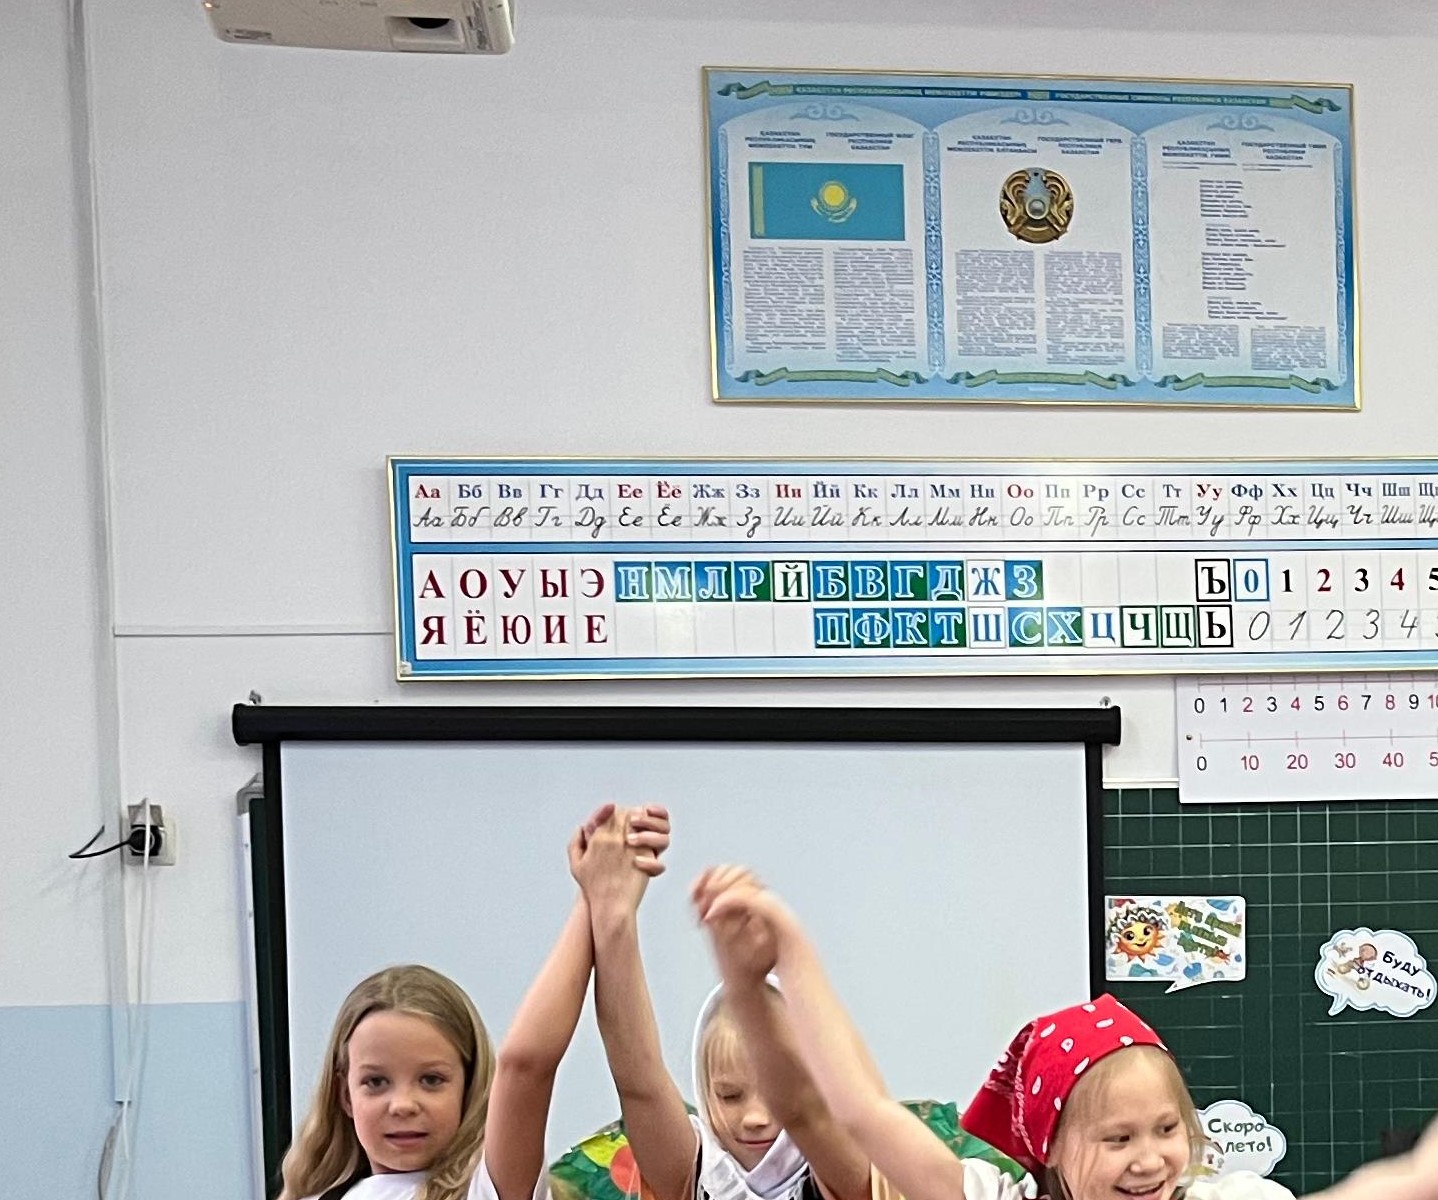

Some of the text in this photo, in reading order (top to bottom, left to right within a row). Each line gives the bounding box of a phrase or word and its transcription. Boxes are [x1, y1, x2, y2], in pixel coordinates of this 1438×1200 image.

[415, 485, 440, 498] Аа
[458, 484, 481, 498] Бб
[499, 484, 522, 498] Вв
[541, 485, 563, 498] Гг
[576, 484, 604, 500] Дд
[618, 484, 642, 498] Ее
[658, 481, 681, 498] Ёё
[693, 484, 724, 498] Жж
[736, 484, 760, 498] Зз
[776, 484, 801, 498] Ии
[814, 482, 840, 498] Йй
[854, 484, 877, 498] Кк
[891, 484, 918, 498] Лл
[931, 485, 959, 497] Мм
[971, 485, 994, 498] Нн
[1008, 485, 1033, 498] Оо
[1046, 485, 1069, 498] Пп
[1084, 485, 1109, 500] Рр
[1122, 484, 1145, 498] Сс
[1163, 484, 1181, 497] Тт
[1197, 484, 1219, 500] Уу
[1232, 484, 1263, 500] Фф
[1273, 484, 1297, 497] Хх
[1312, 484, 1334, 499] Цц
[1346, 484, 1371, 496] Чч
[1383, 483, 1410, 496] Шш
[1244, 570, 1258, 592] 0
[1283, 569, 1292, 592] 1
[1318, 569, 1331, 591] 2
[1355, 568, 1368, 591] 3
[1391, 568, 1404, 590] 4
[1249, 611, 1270, 640] 0
[1290, 611, 1306, 640] 1
[1326, 610, 1344, 639] 2
[1363, 609, 1379, 639] 3
[1401, 610, 1417, 638] 4
[1194, 698, 1204, 713] 0
[1221, 698, 1226, 712] 1
[1243, 697, 1253, 712] 2
[1267, 697, 1277, 712] 3
[1291, 697, 1300, 710] 4
[1315, 696, 1324, 711] 5
[1338, 695, 1348, 710] 6
[1362, 695, 1371, 710] 7
[1386, 695, 1395, 710] 8
[1409, 694, 1419, 709] 9
[1197, 756, 1207, 771] 0
[1241, 755, 1259, 770] 10
[1287, 754, 1308, 769] 20
[1335, 753, 1355, 768] 30
[1383, 753, 1403, 767] 40
[1383, 951, 1420, 976] Буду
[1357, 966, 1431, 1000] отдыхать!
[1208, 1119, 1264, 1136] Скоро
[1225, 1136, 1272, 1152] лето!
